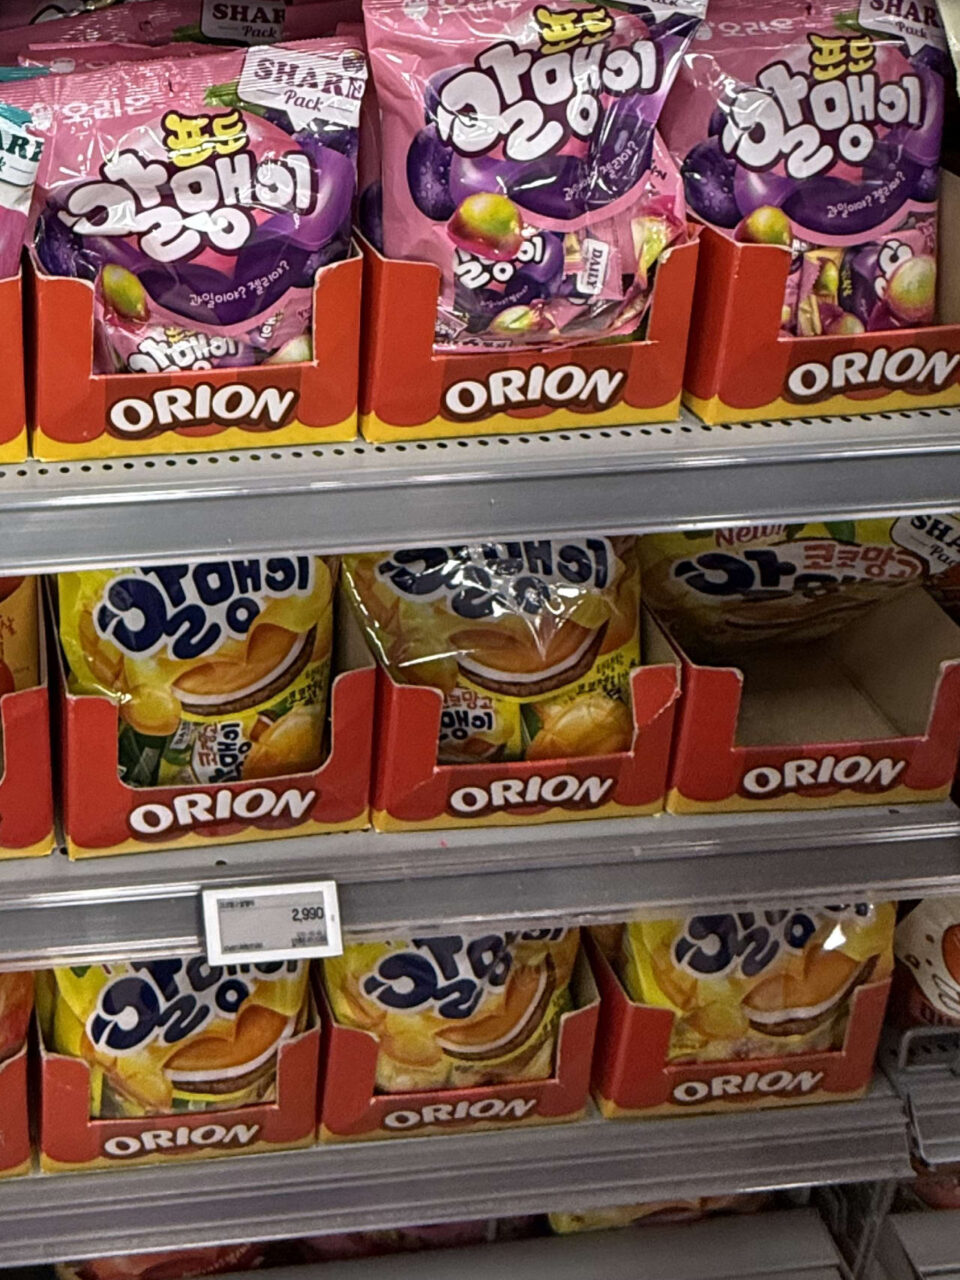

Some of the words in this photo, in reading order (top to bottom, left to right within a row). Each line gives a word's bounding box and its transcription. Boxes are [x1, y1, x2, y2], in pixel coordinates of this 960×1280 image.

[212, 3, 285, 24] SHAR
[241, 24, 277, 40] Pack
[535, 7, 613, 55] 포도
[718, 18, 795, 37] 오리온
[895, 19, 930, 40] Pack
[808, 33, 875, 81] 포도
[283, 87, 325, 114] Pack
[436, 40, 657, 161] 알맹이
[721, 62, 922, 180] 알맹이
[164, 111, 249, 167] 포도
[58, 152, 312, 263] 알맹이
[826, 195, 873, 220] 과일이야?
[872, 170, 906, 204] 젤리야?
[188, 283, 247, 309] 과일이야?
[247, 259, 290, 295] 젤리야?
[584, 248, 604, 291] DAILY
[445, 365, 626, 415] ORION
[786, 349, 957, 399] ORION
[110, 383, 298, 433] ORION
[97, 556, 309, 660] 알맹이
[450, 775, 613, 812] ORION
[743, 756, 906, 794] ORION
[129, 788, 316, 834] ORION
[292, 906, 324, 923] 2,990
[672, 1070, 825, 1103] ORION
[384, 1098, 537, 1129] ORION
[104, 1123, 260, 1156] ORION
